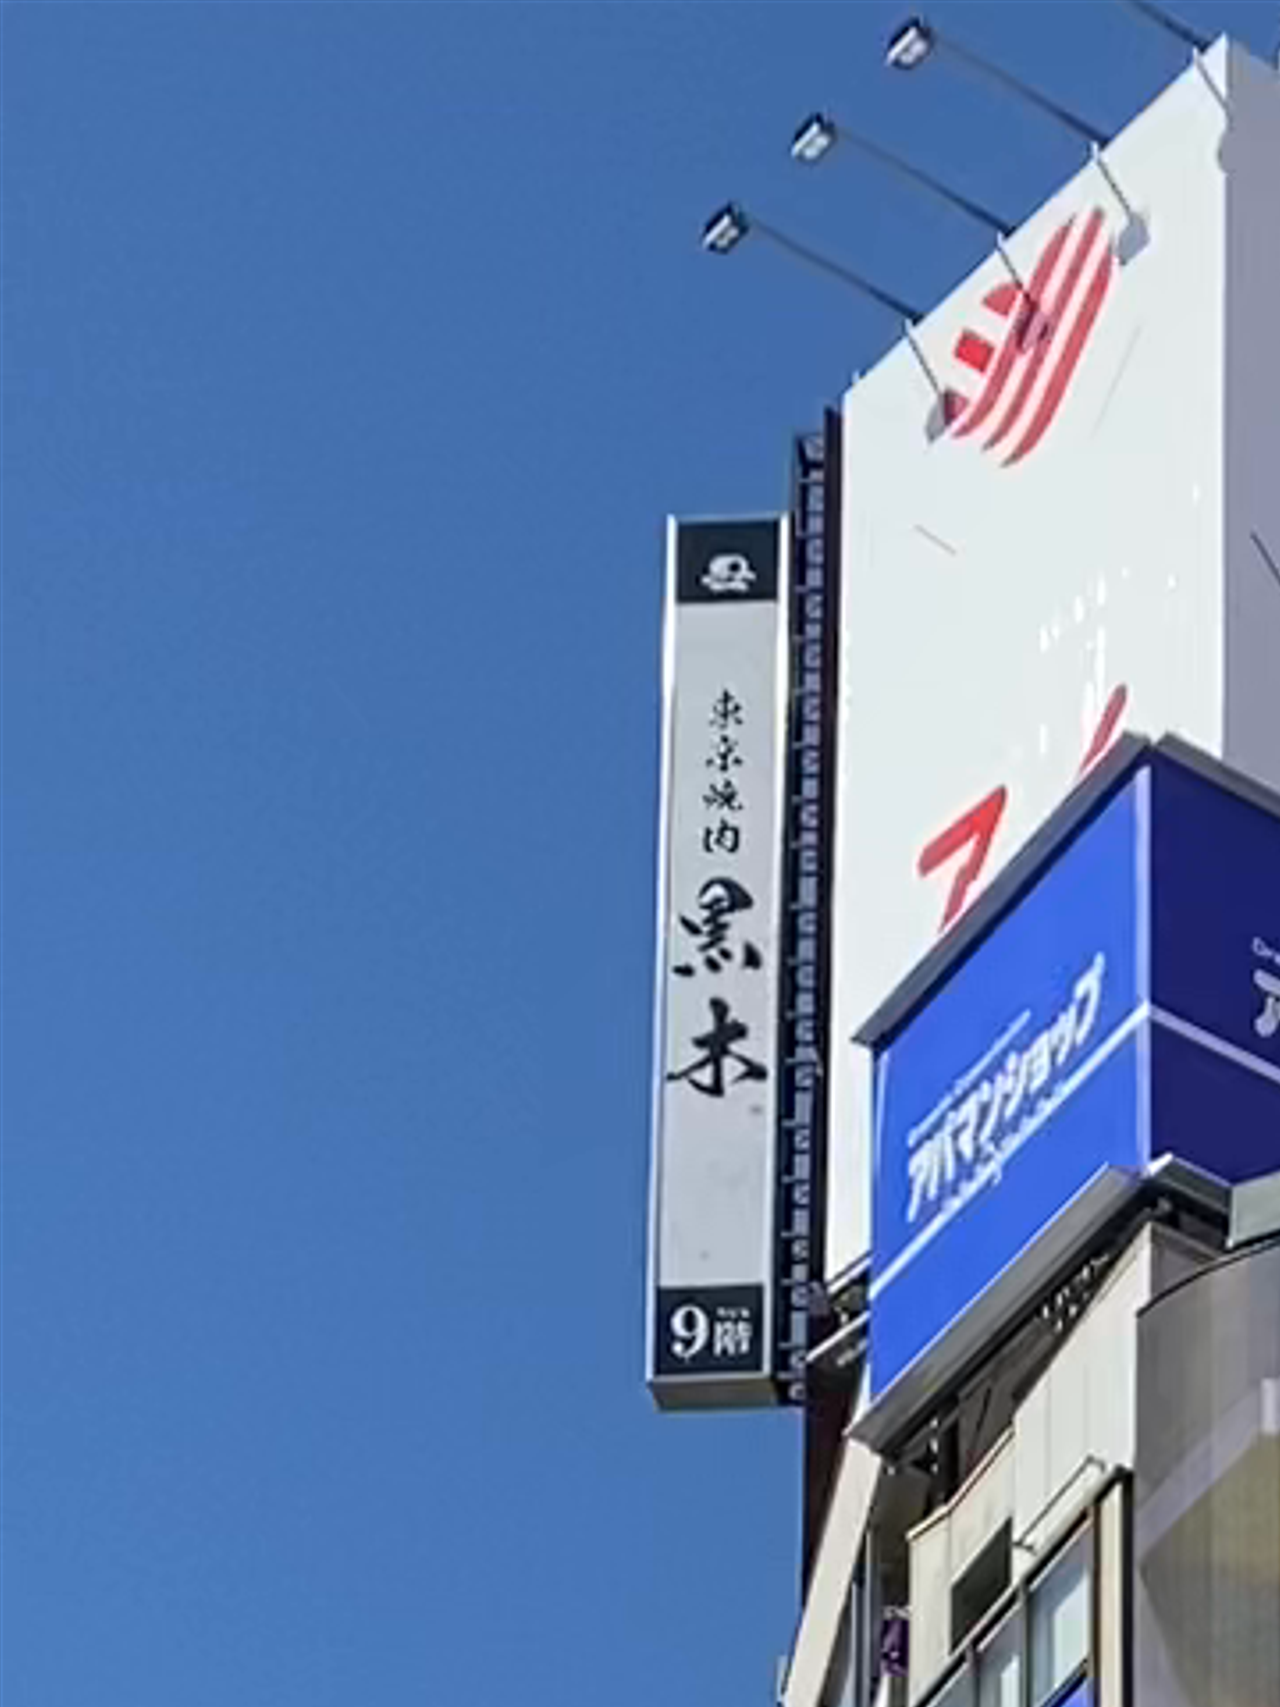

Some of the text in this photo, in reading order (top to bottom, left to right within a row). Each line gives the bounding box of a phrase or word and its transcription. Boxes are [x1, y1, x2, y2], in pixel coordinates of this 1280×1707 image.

[666, 876, 768, 1098] 黒木
[907, 950, 1104, 1223] アパマンショップ
[669, 1304, 754, 1363] 9階
